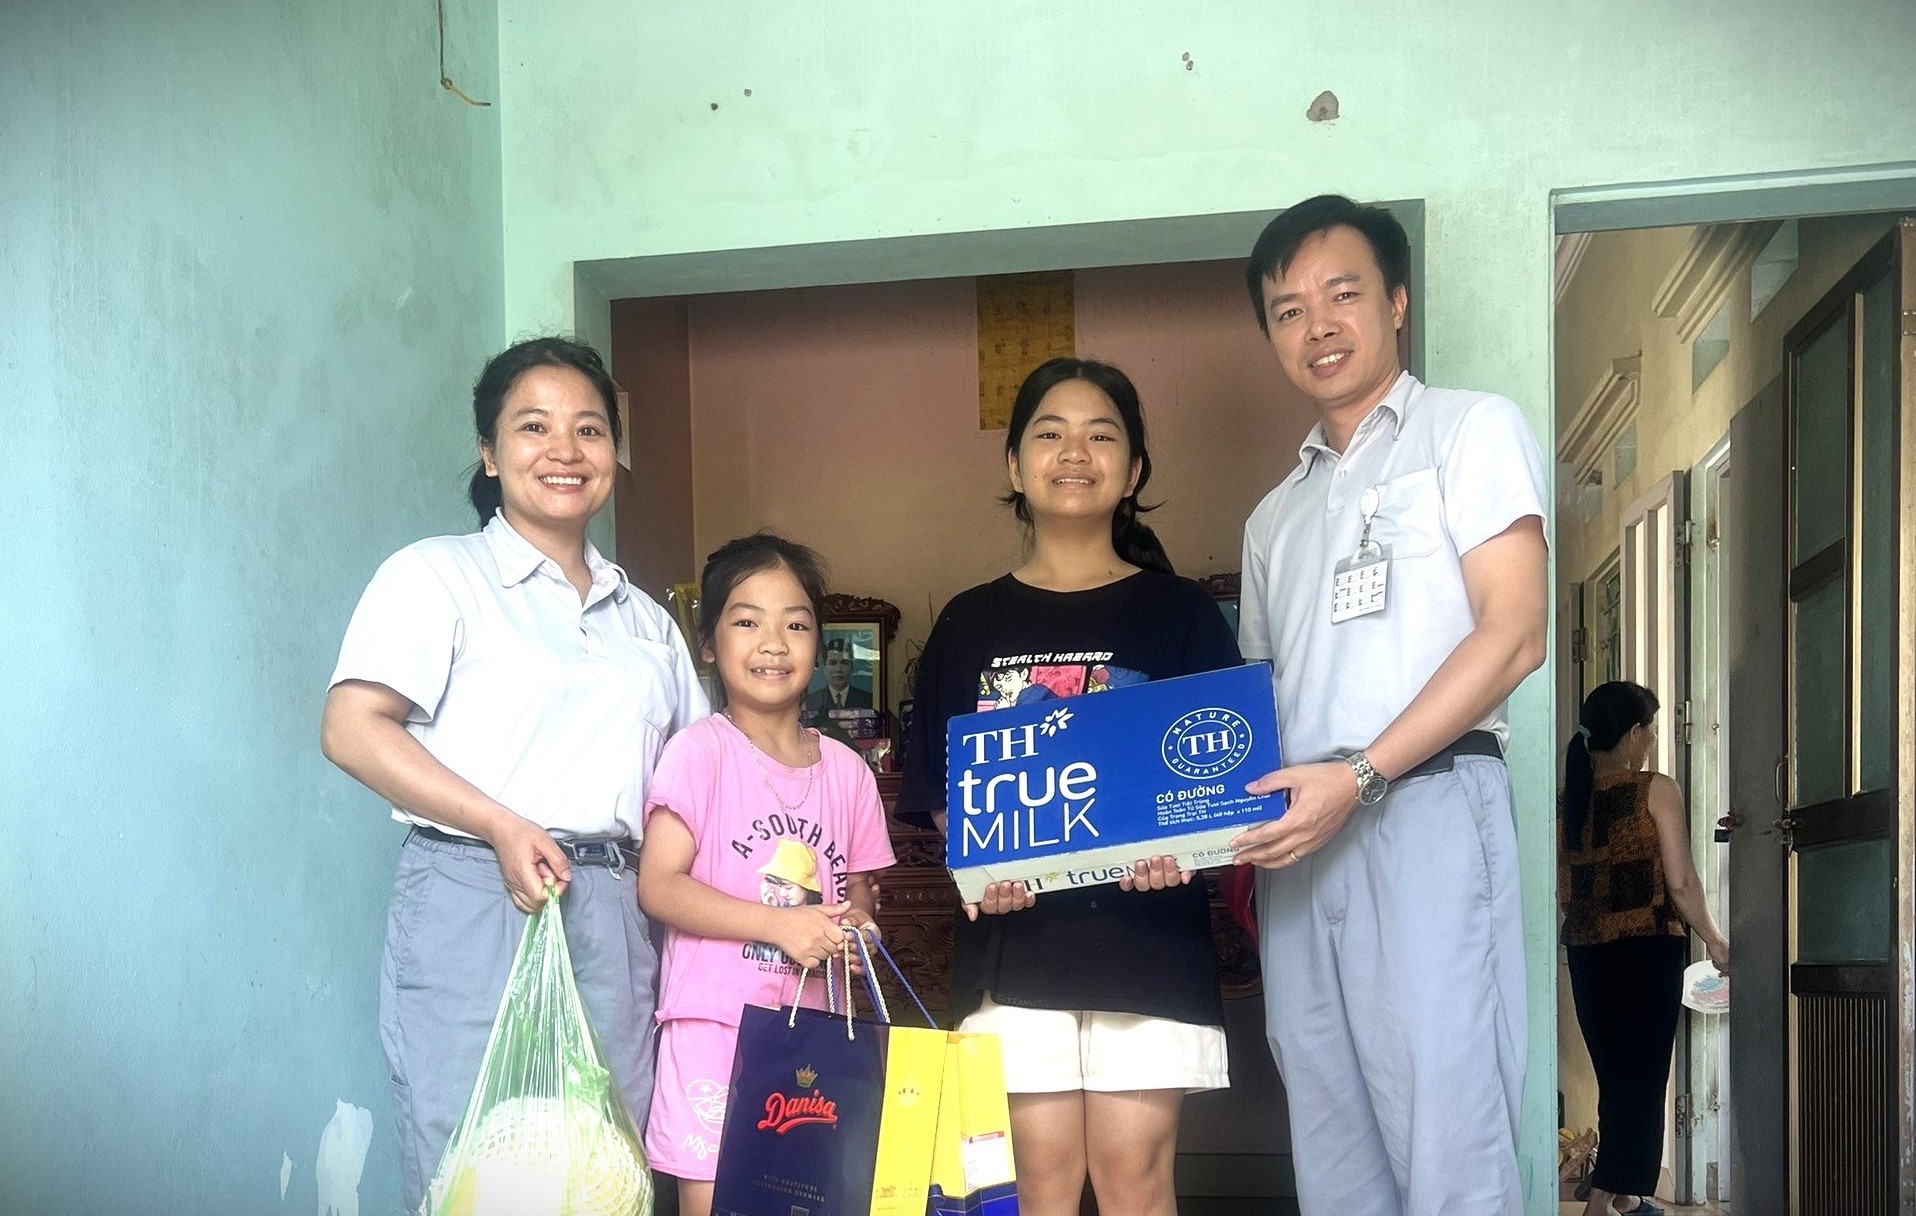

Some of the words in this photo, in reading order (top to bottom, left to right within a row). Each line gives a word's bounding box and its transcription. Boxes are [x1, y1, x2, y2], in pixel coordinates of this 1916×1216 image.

[991, 653, 1051, 668] STEALTH
[1053, 651, 1113, 663] HAZARD
[1172, 711, 1241, 735] NATURE
[962, 724, 1040, 766] TH
[1182, 729, 1231, 756] TH
[1171, 743, 1245, 775] GUARANTEED
[957, 761, 1098, 816] true
[1156, 789, 1174, 804] CÓ
[1177, 784, 1226, 801] ĐƯỜNG
[962, 798, 1100, 858] MILK
[731, 813, 823, 860] A-SOUTH
[823, 840, 848, 904] BEAC
[742, 941, 778, 963] ONLY
[758, 962, 773, 972] GET
[774, 965, 792, 976] LOST
[757, 1088, 839, 1134] Danisa
